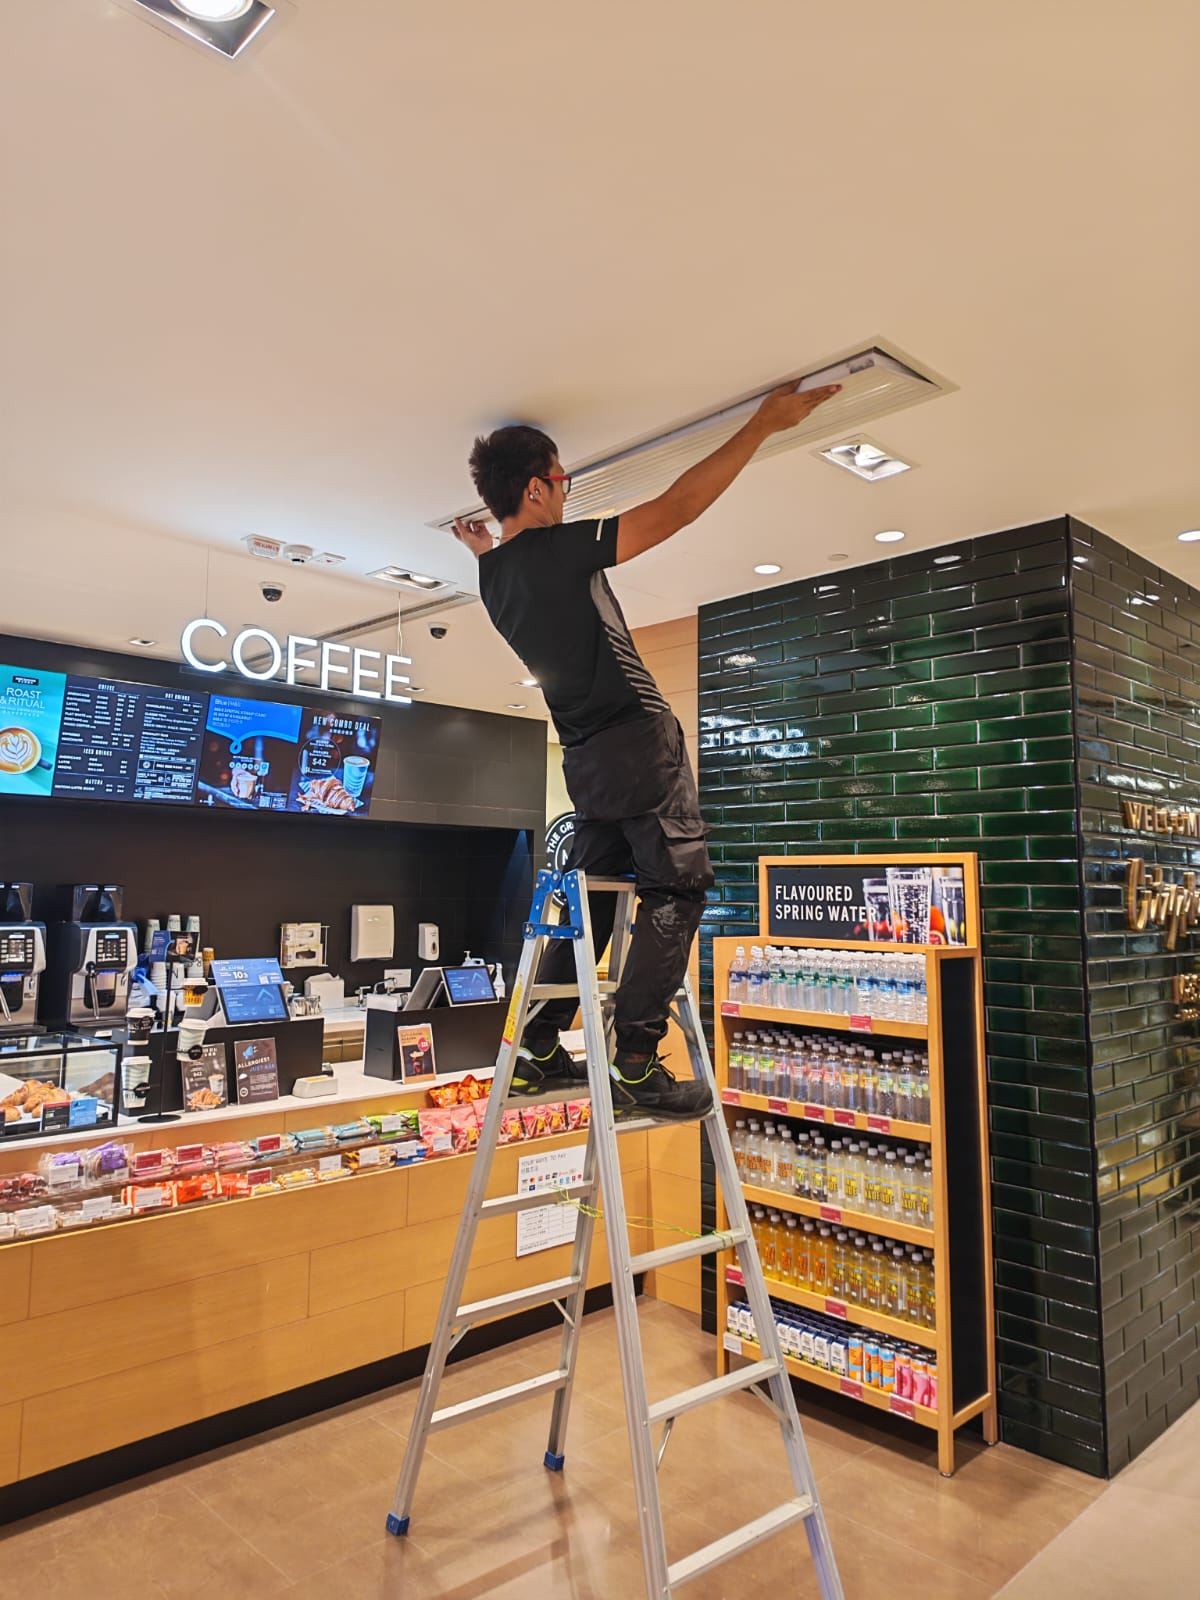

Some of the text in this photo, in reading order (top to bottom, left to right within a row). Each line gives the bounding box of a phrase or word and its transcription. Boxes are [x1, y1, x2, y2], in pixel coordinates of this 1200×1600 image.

[180, 618, 412, 704] COFFEE
[6, 687, 42, 699] ROAST
[8, 697, 45, 709] RITUAL
[313, 715, 370, 732] NEW COMBO DEAL
[312, 758, 327, 766] $42
[1123, 799, 1200, 838] WELCOM
[546, 831, 561, 854] THE
[775, 885, 853, 902] FLAVOURED
[775, 904, 877, 922] SPRING WATER
